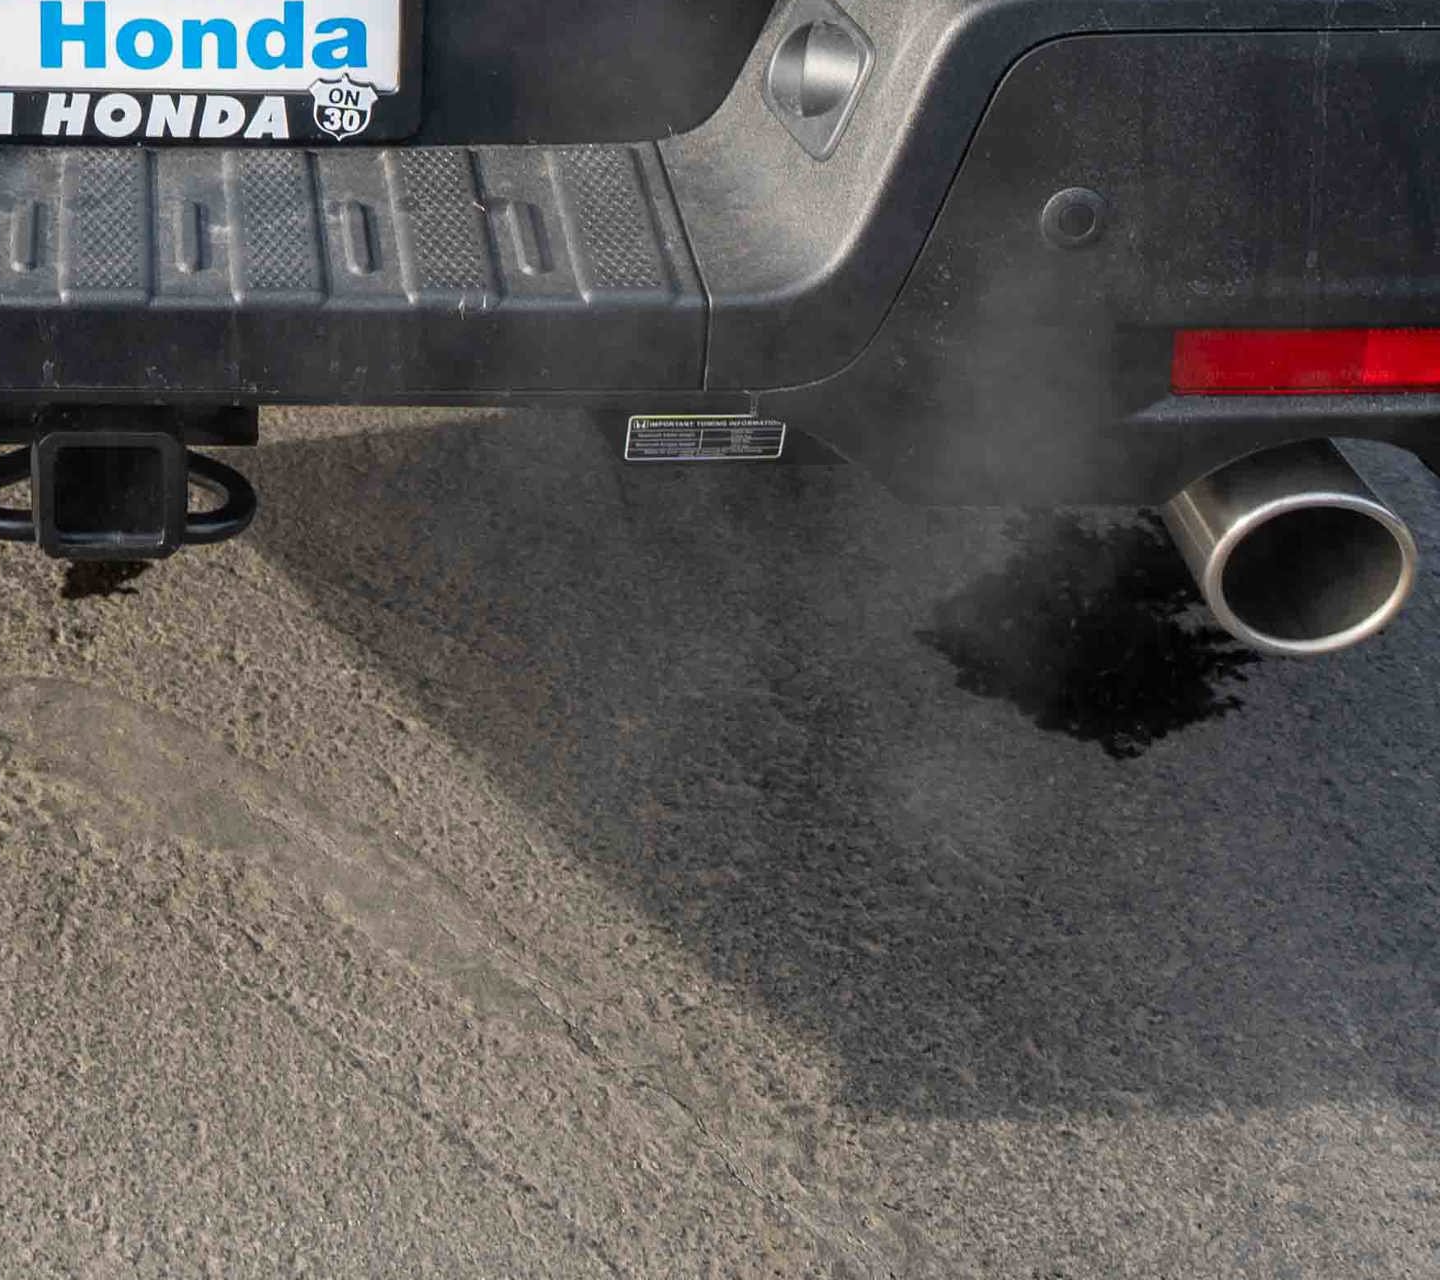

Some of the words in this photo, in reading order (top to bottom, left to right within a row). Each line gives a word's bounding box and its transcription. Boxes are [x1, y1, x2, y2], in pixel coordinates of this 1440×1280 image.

[39, 0, 368, 71] Honda
[41, 91, 290, 140] HONDA
[328, 87, 361, 107] ON
[322, 107, 361, 132] 30
